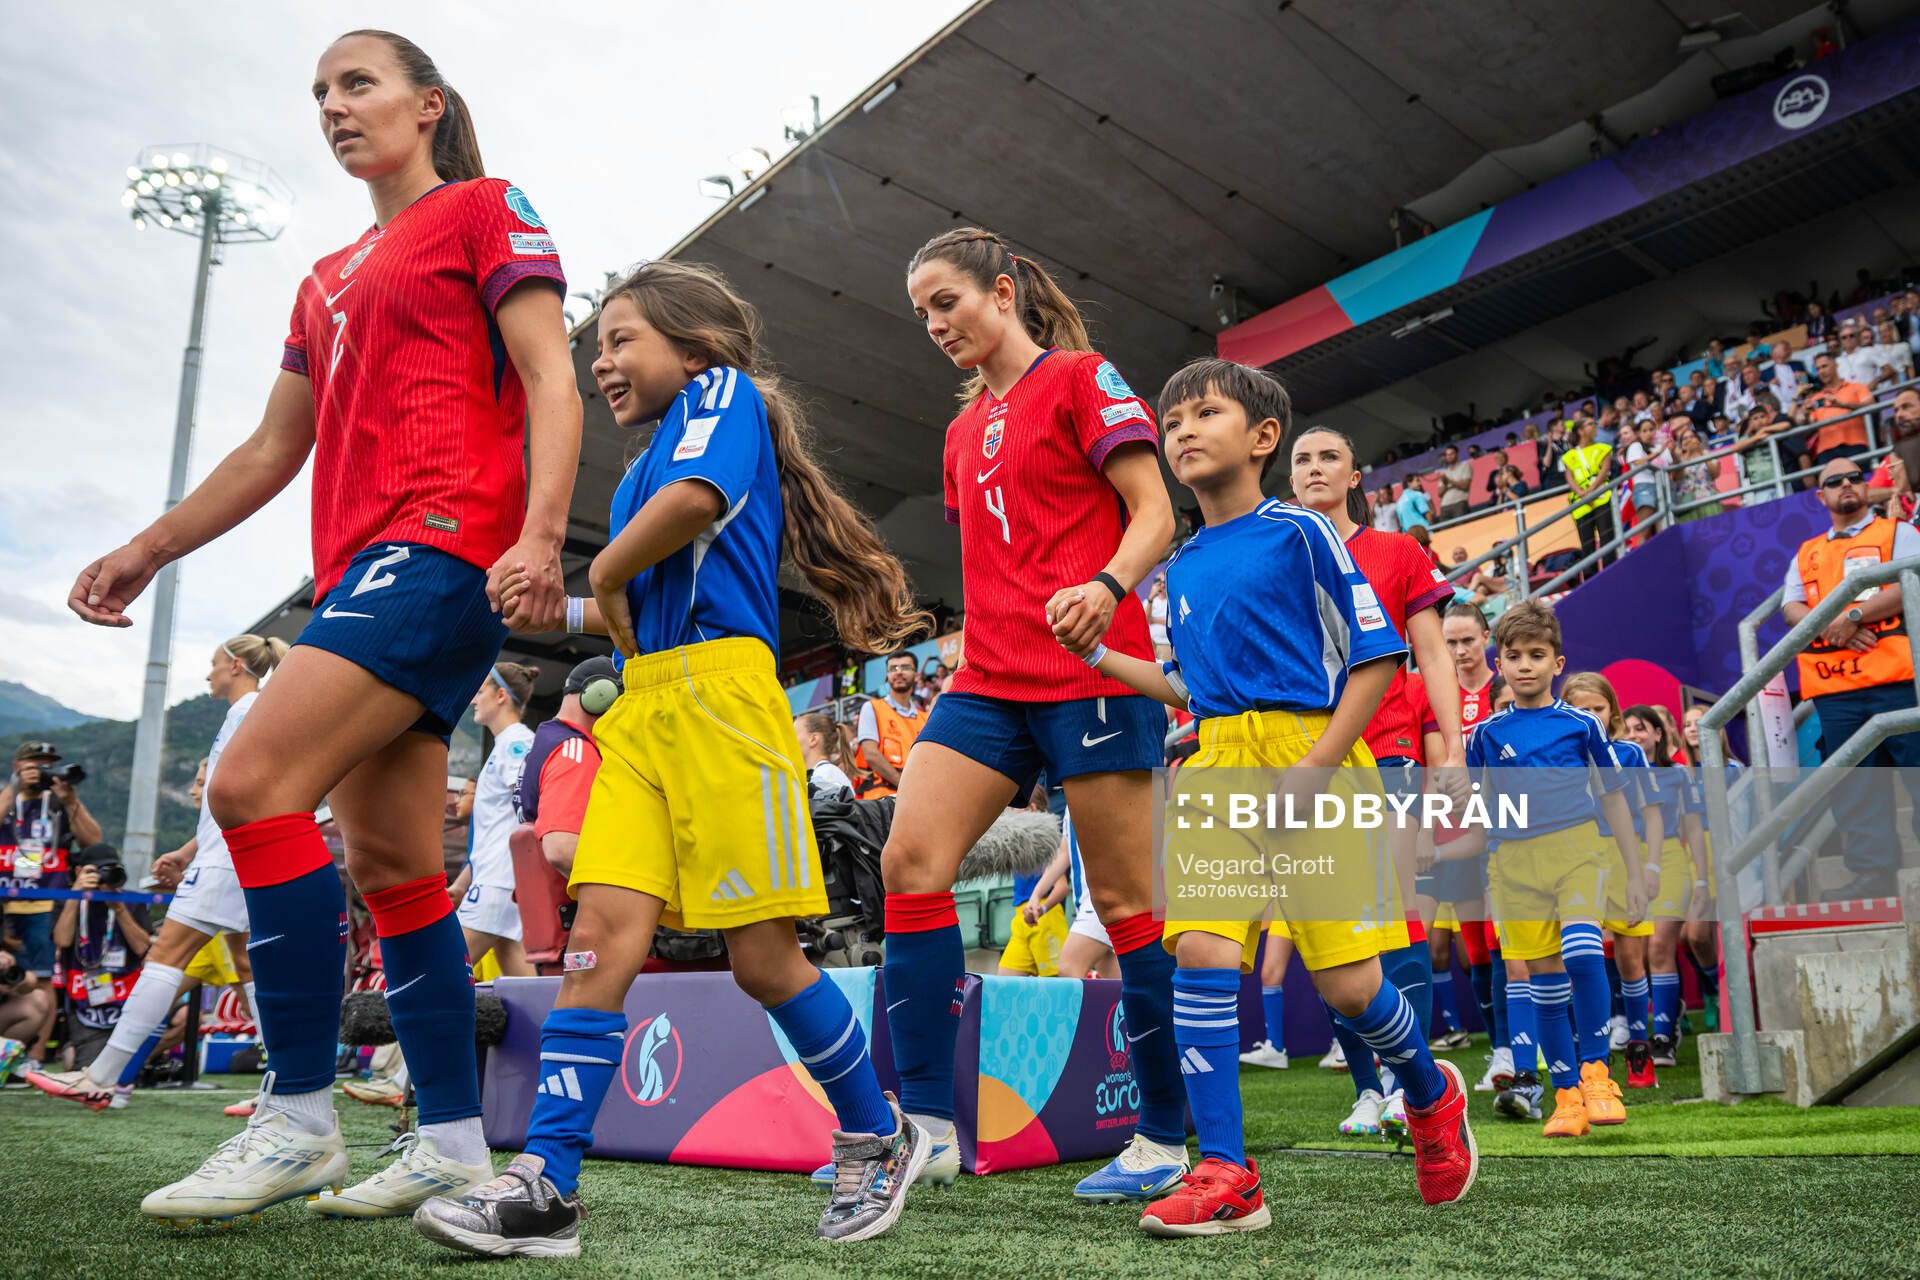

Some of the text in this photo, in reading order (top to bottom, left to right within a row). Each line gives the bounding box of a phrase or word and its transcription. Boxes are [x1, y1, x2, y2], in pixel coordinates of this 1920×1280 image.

[985, 485, 1011, 545] 4
[350, 545, 410, 598] 2
[1105, 1071, 1132, 1083] women's
[273, 1148, 325, 1161] F50
[422, 1167, 470, 1187] F50
